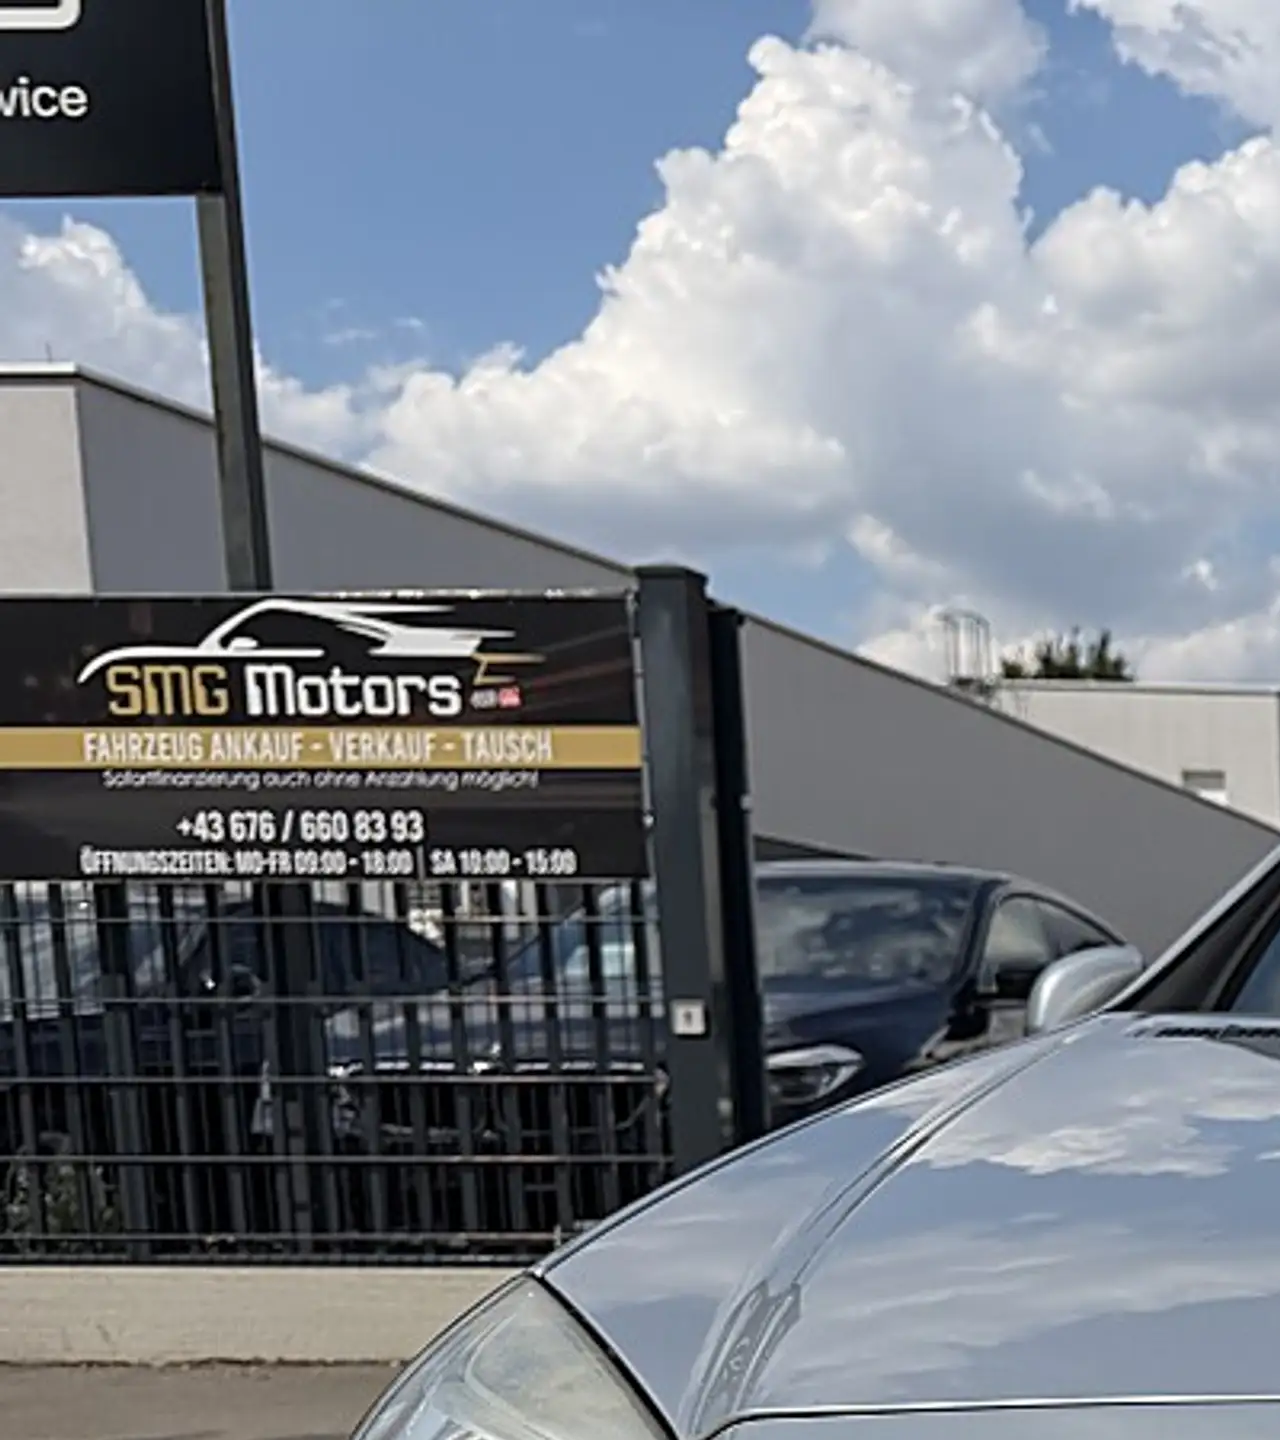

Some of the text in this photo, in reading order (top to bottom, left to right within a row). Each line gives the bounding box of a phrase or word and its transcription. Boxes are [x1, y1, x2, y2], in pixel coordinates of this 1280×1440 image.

[105, 664, 229, 716] SMG
[243, 663, 463, 717] Motors
[83, 731, 204, 763] FAHRZEUG
[209, 730, 304, 763] ANKAUF
[328, 730, 438, 763] VERKAUF
[461, 729, 553, 763] TAUSCH
[175, 808, 425, 843] +43 676 / 660 83 93
[429, 848, 457, 875] SA
